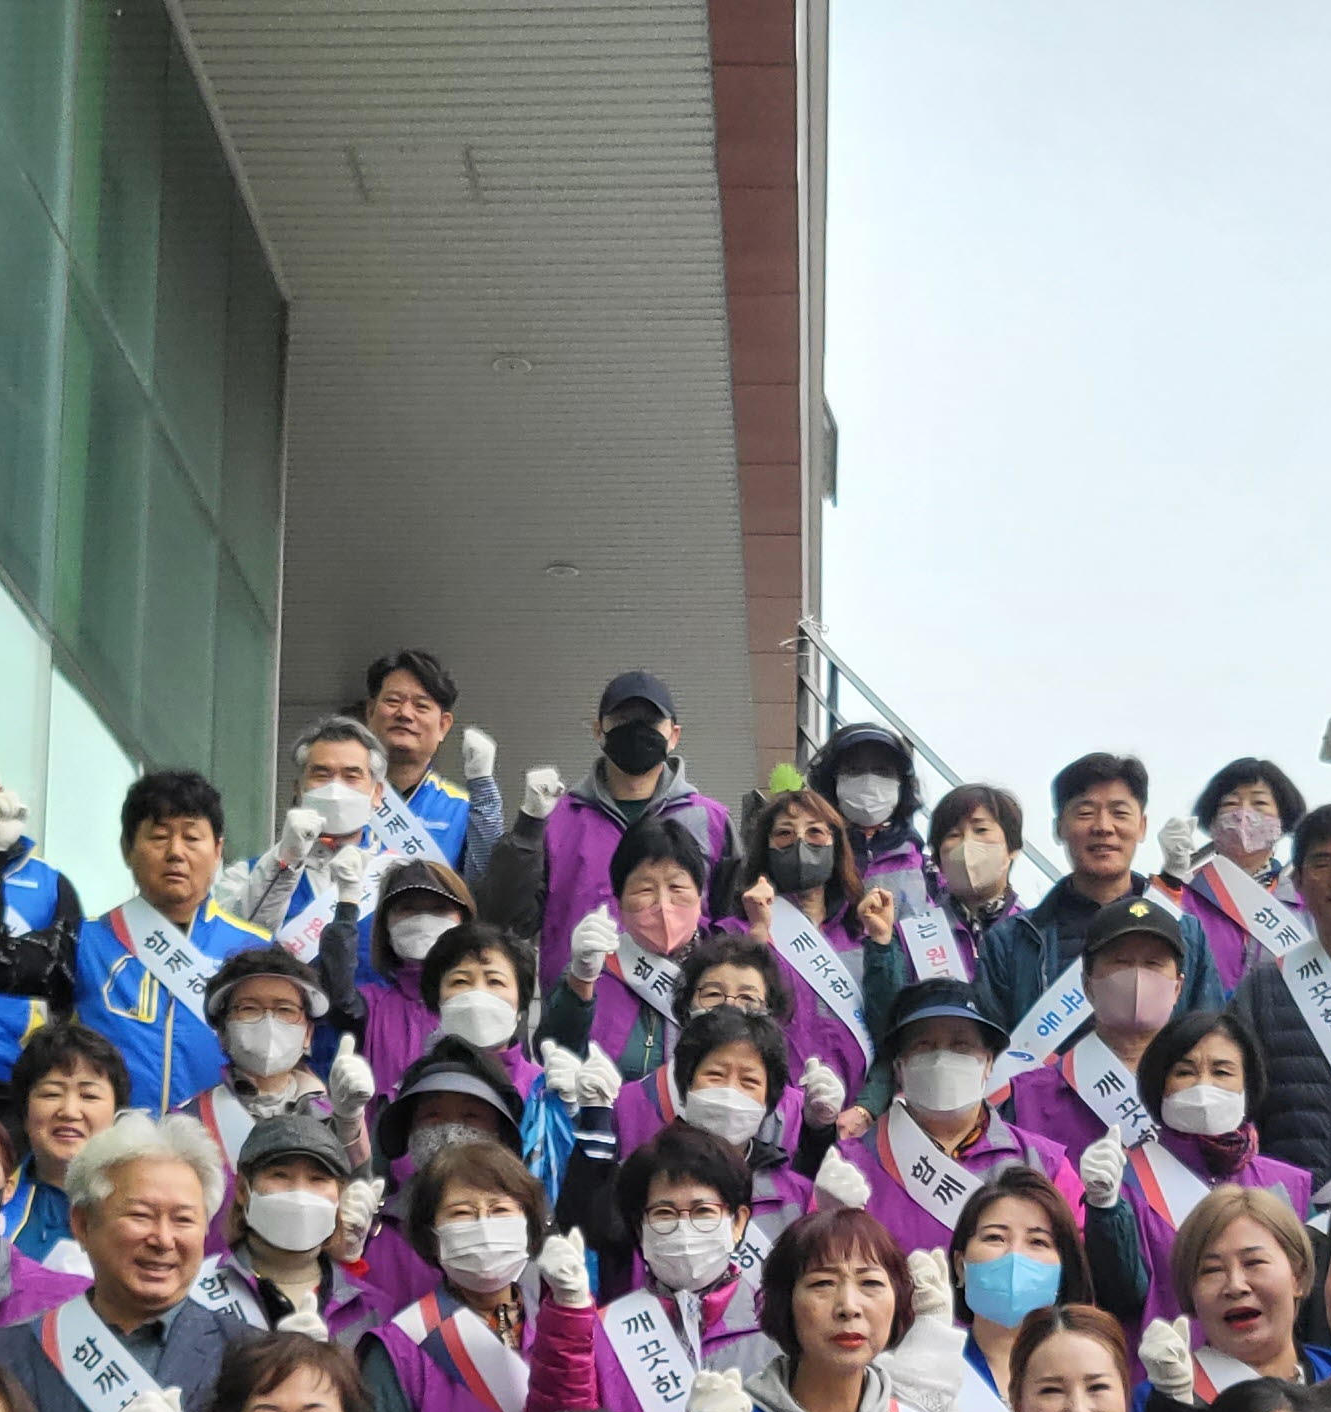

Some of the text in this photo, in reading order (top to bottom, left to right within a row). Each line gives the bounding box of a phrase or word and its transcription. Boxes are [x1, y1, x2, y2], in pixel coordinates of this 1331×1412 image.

[1253, 907, 1300, 949] 함께
[633, 956, 675, 997] 함께
[791, 931, 854, 1000] 깨끗한
[911, 1156, 967, 1205] 함께
[72, 1335, 134, 1412] 함께
[622, 1310, 685, 1403] 깨끗한
